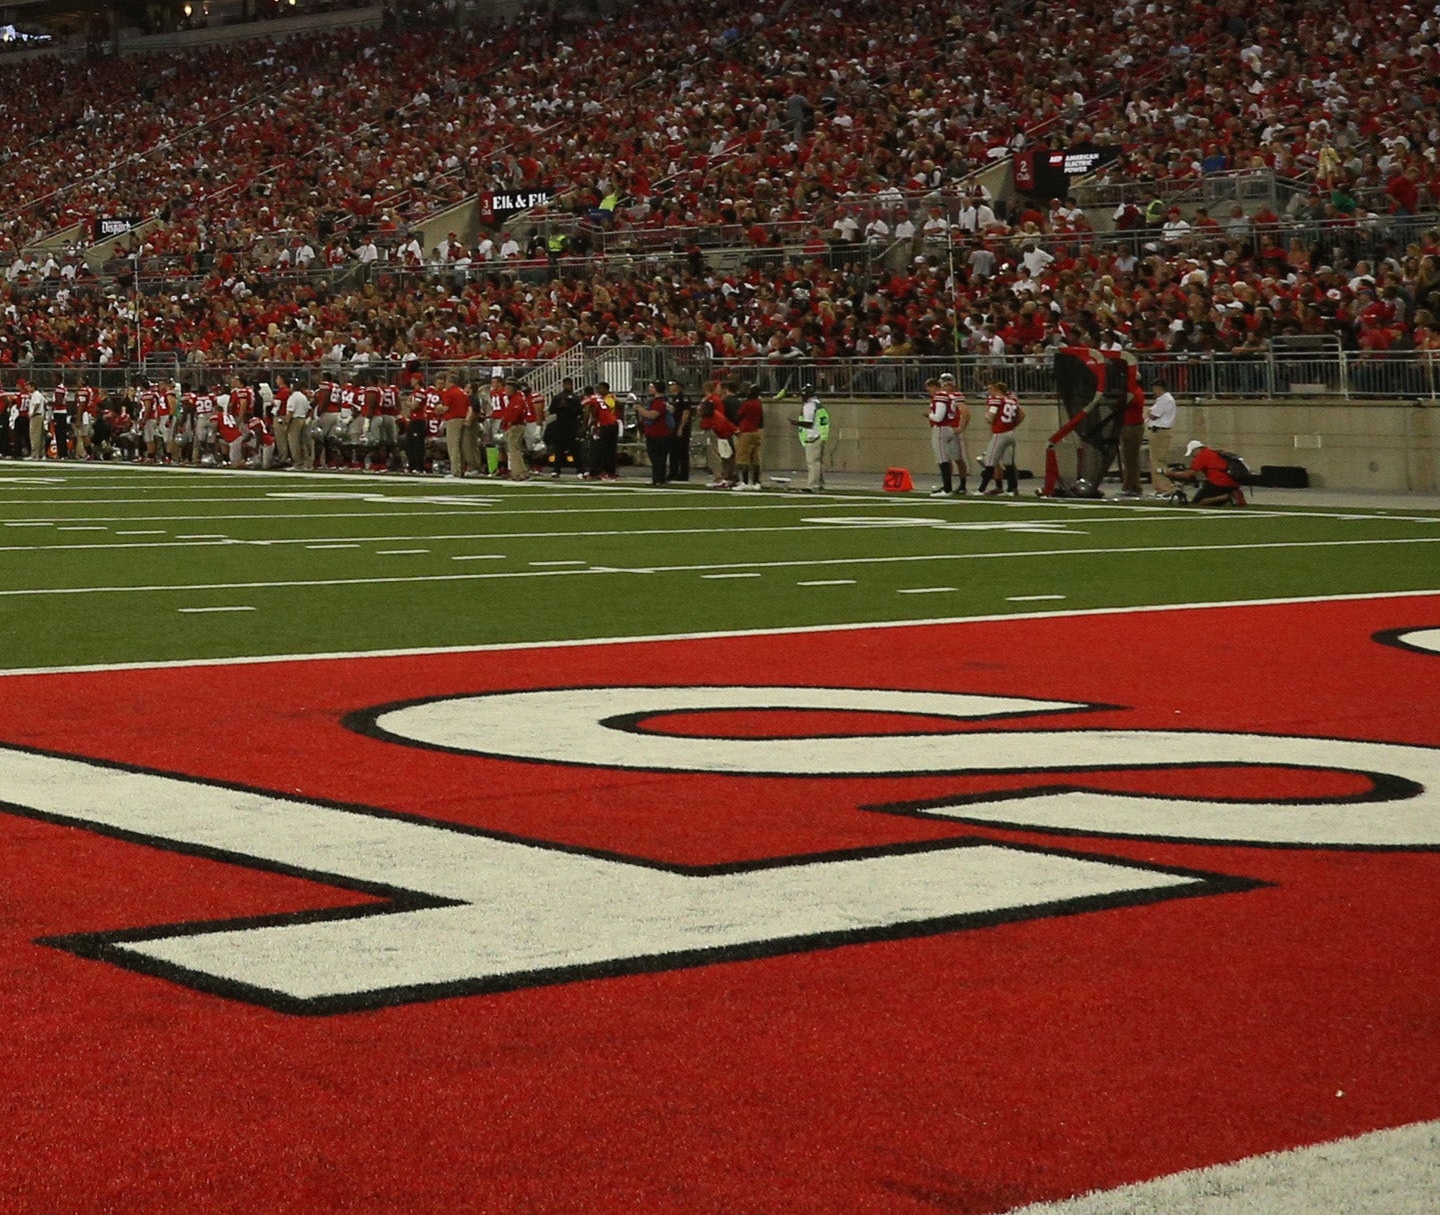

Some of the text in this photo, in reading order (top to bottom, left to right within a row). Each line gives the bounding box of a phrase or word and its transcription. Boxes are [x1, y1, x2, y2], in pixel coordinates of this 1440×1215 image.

[1065, 153, 1099, 161] AMERICAN
[1020, 161, 1028, 172] 2
[1064, 166, 1087, 174] POWER
[493, 195, 514, 210] Elk
[515, 194, 527, 209] &
[195, 399, 213, 414] 29
[885, 471, 903, 488] 20
